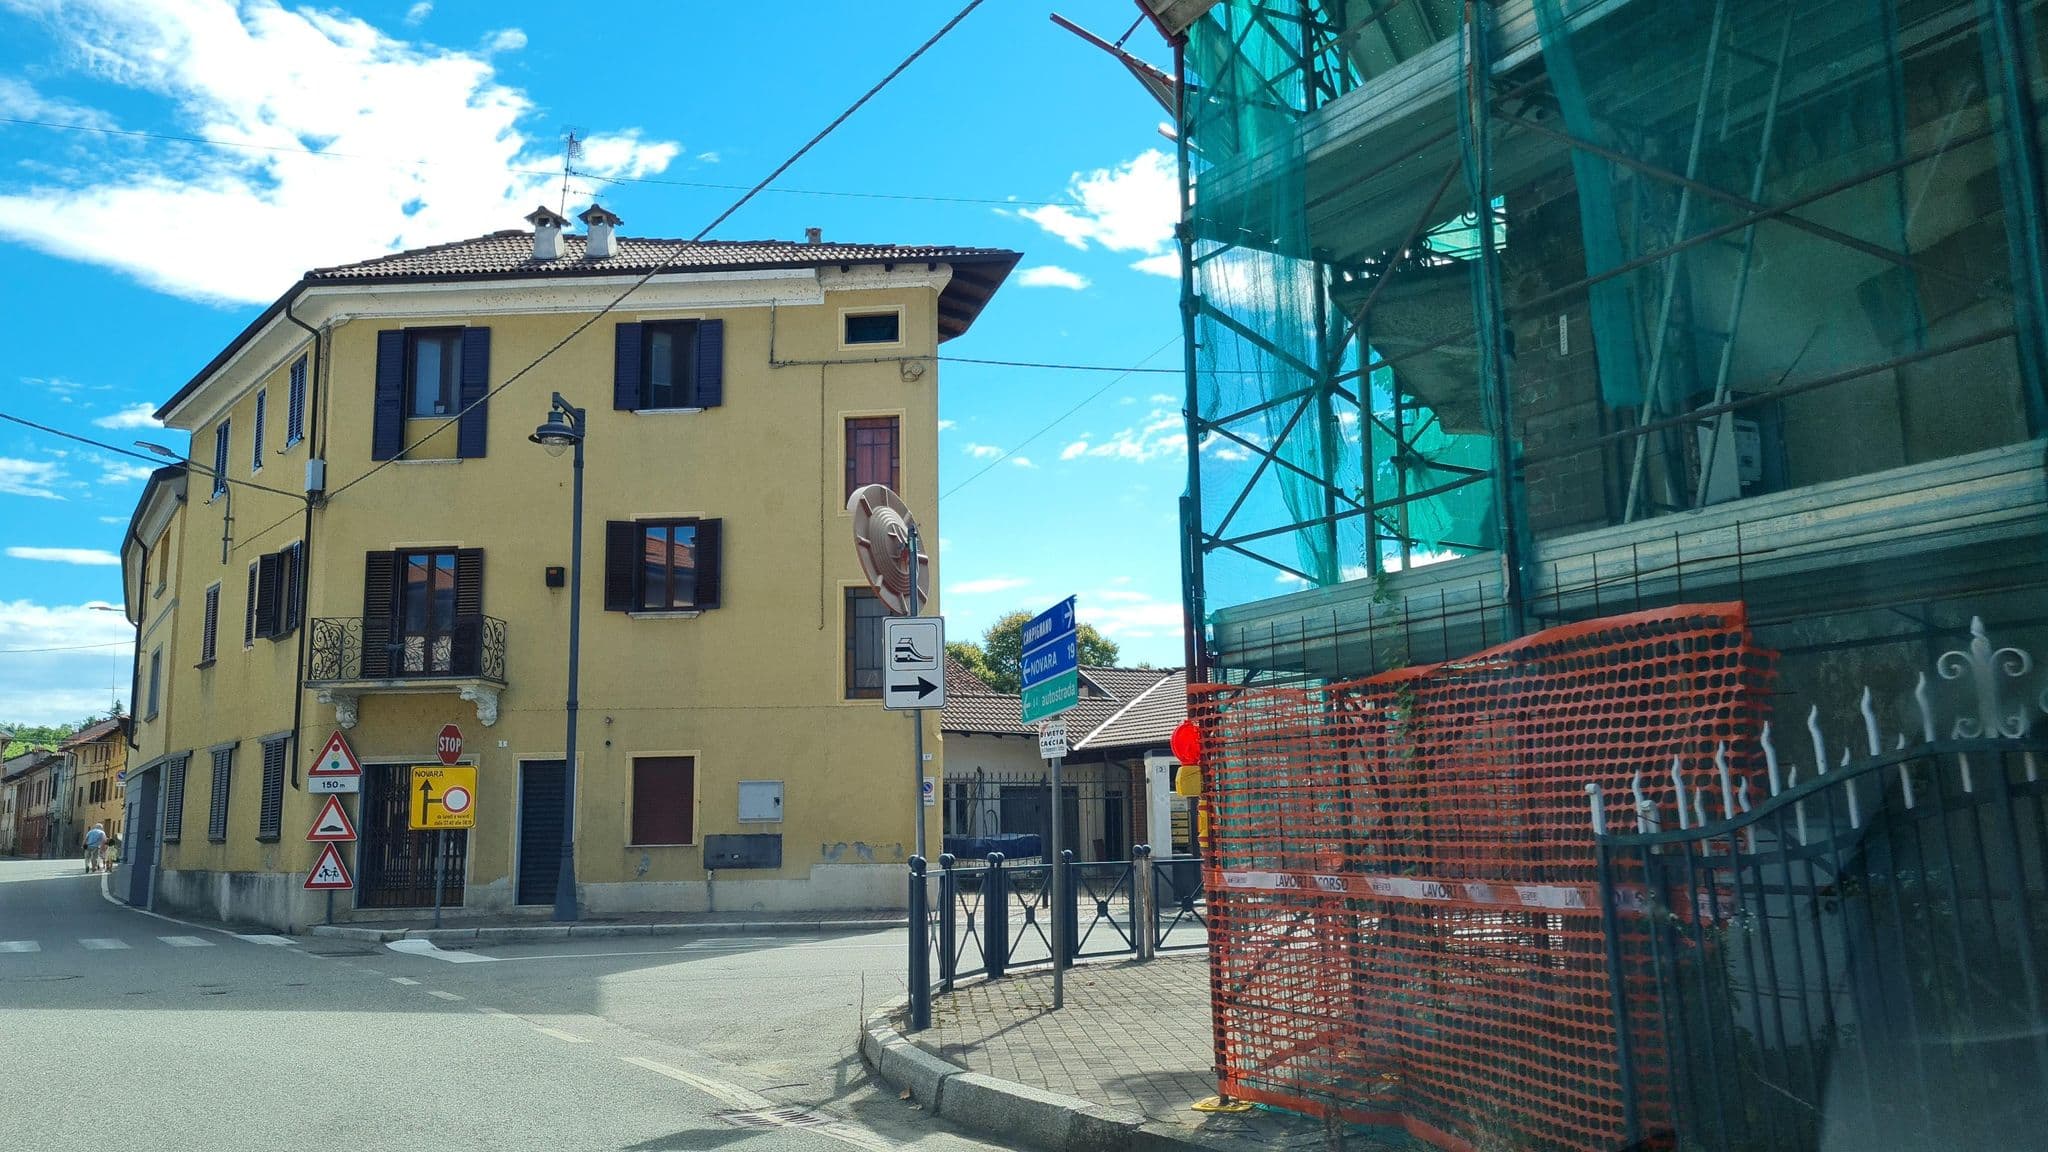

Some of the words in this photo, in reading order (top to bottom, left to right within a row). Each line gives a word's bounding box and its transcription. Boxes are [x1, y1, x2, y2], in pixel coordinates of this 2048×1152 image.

[1023, 617, 1053, 646] CARPIGNANO
[1030, 651, 1058, 678] NOVARA
[1067, 642, 1075, 660] 19
[1041, 682, 1076, 707] autostrada
[439, 736, 462, 753] STOP
[1040, 739, 1064, 747] CACCIA
[414, 770, 444, 778] NOVARA
[322, 781, 339, 789] 150
[1275, 874, 1307, 888] LAVORI
[1318, 877, 1349, 891] CORSO
[1421, 883, 1458, 899] LAVORI
